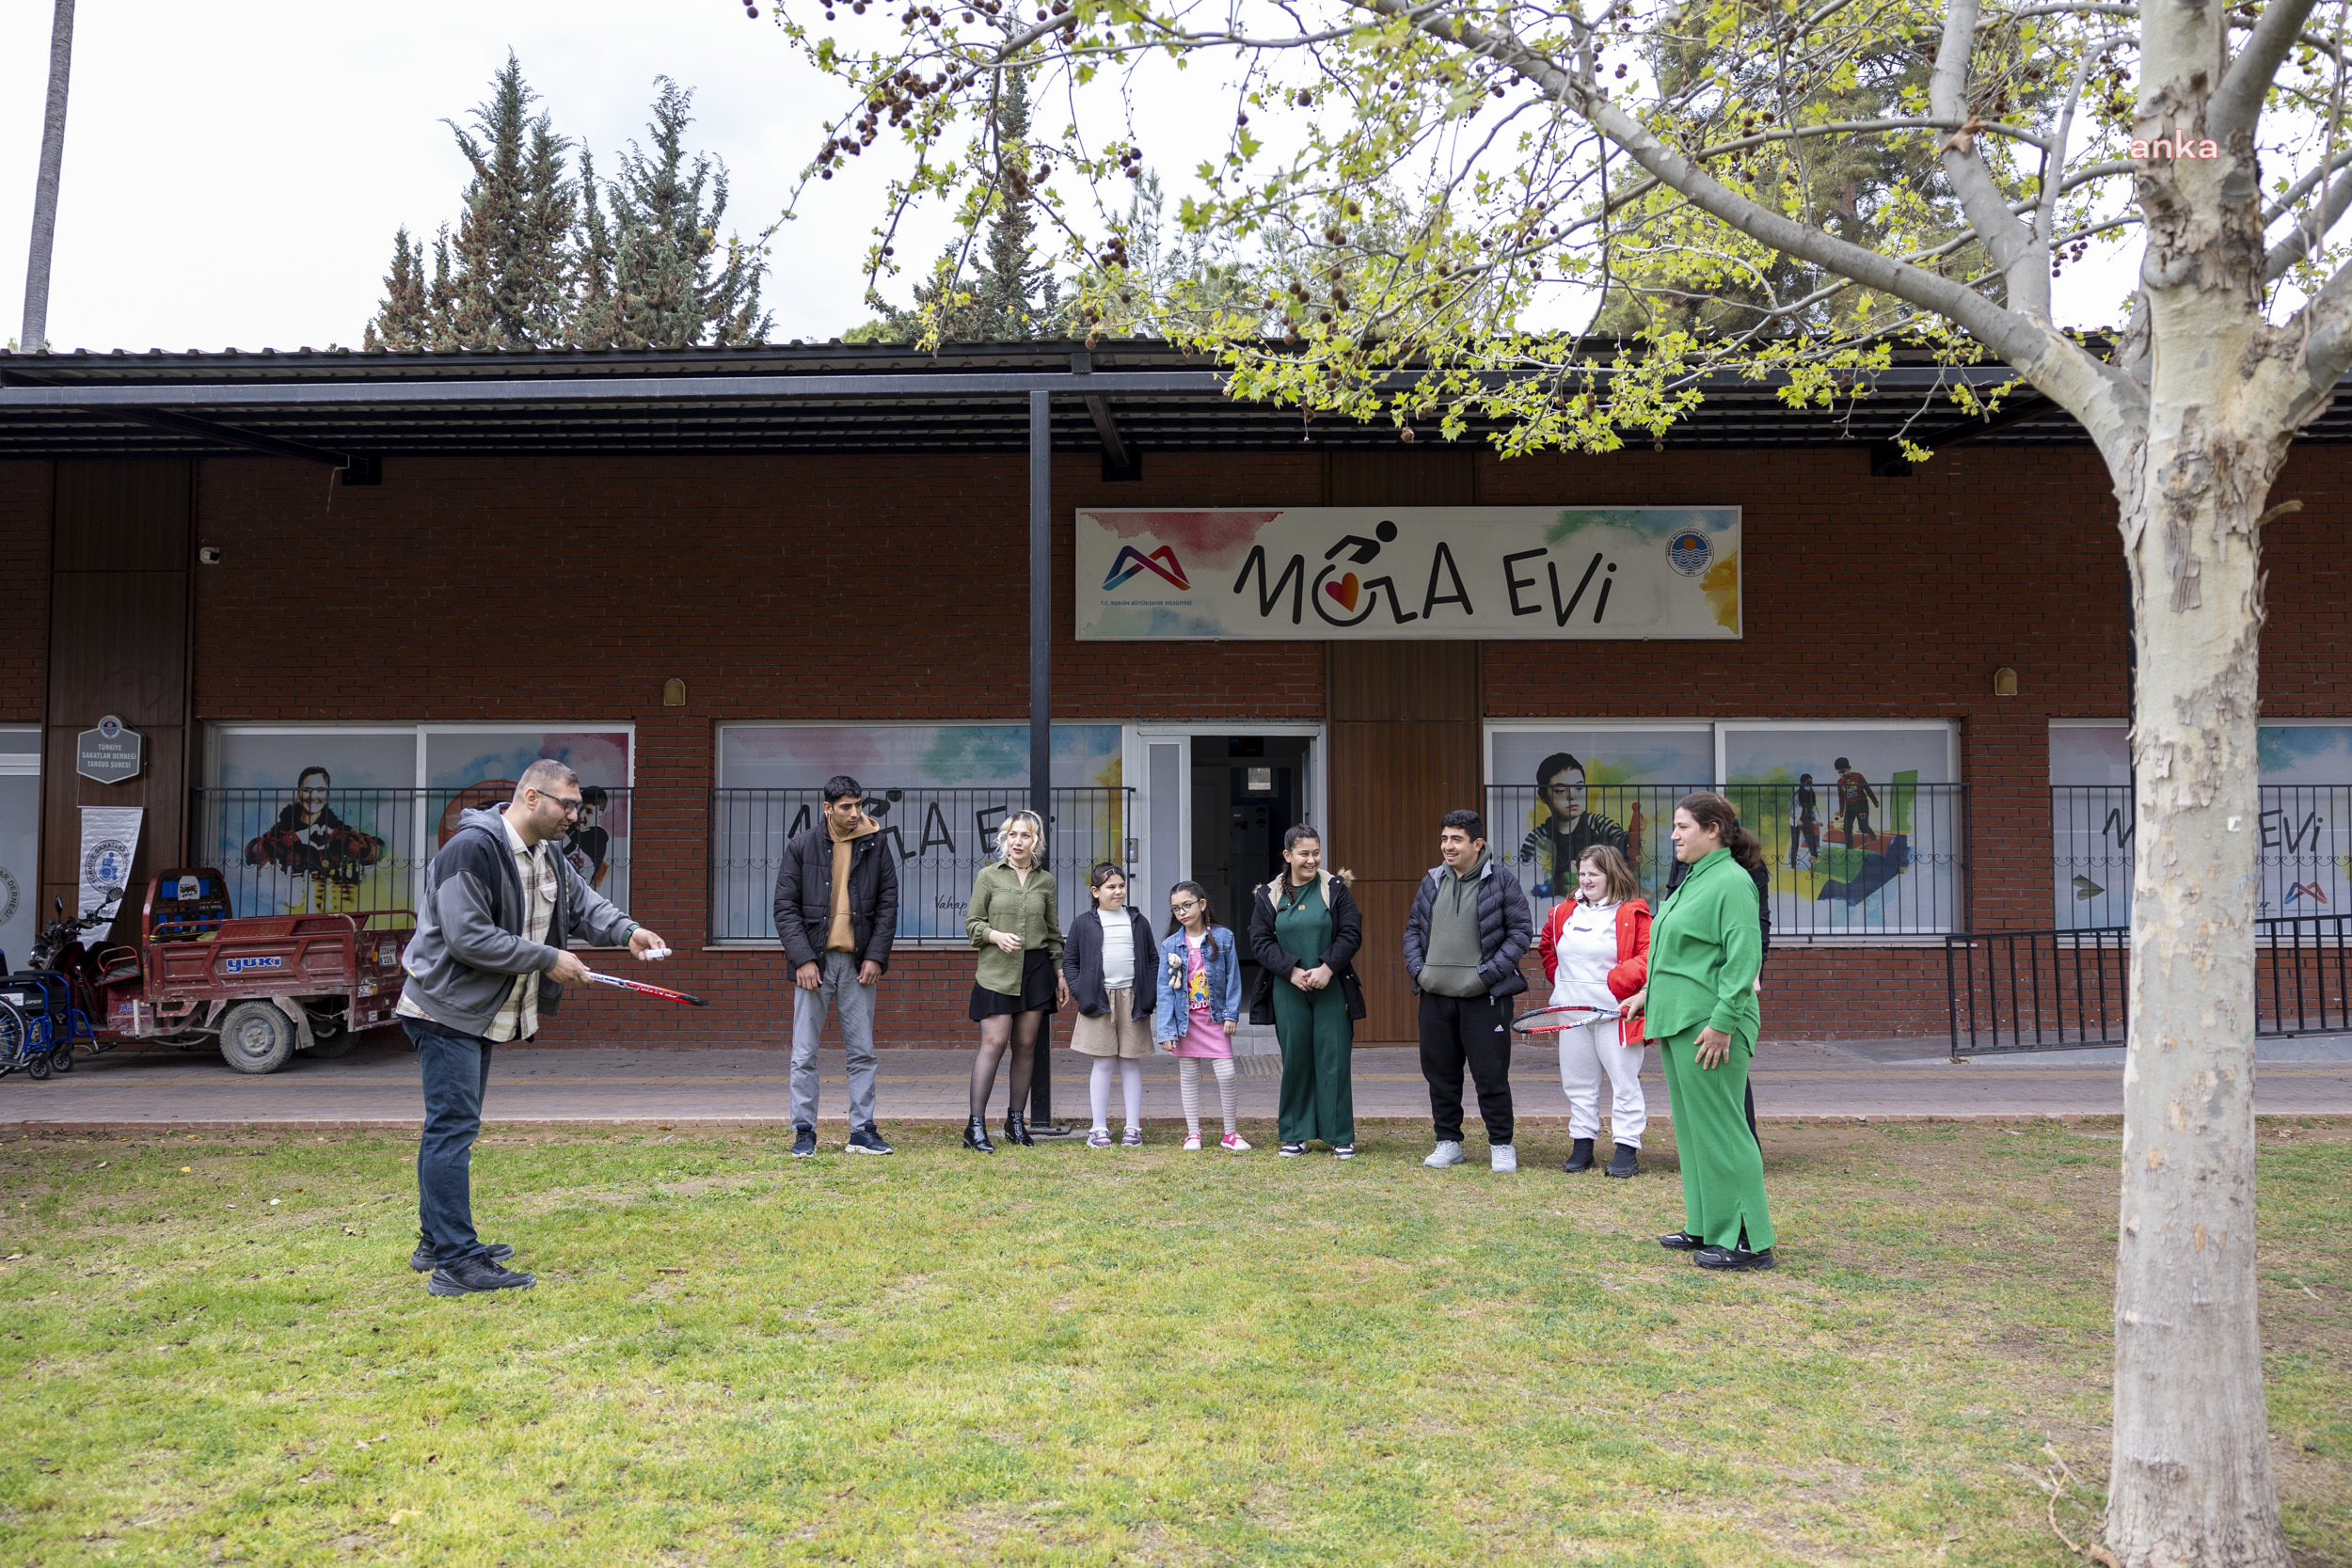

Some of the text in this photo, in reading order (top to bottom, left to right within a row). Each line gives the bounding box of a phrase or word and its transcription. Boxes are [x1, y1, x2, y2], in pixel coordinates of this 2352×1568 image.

[1233, 540, 1474, 627] MOLA
[110, 761, 132, 769] ŞUBESİ
[934, 894, 968, 916] Vahap
